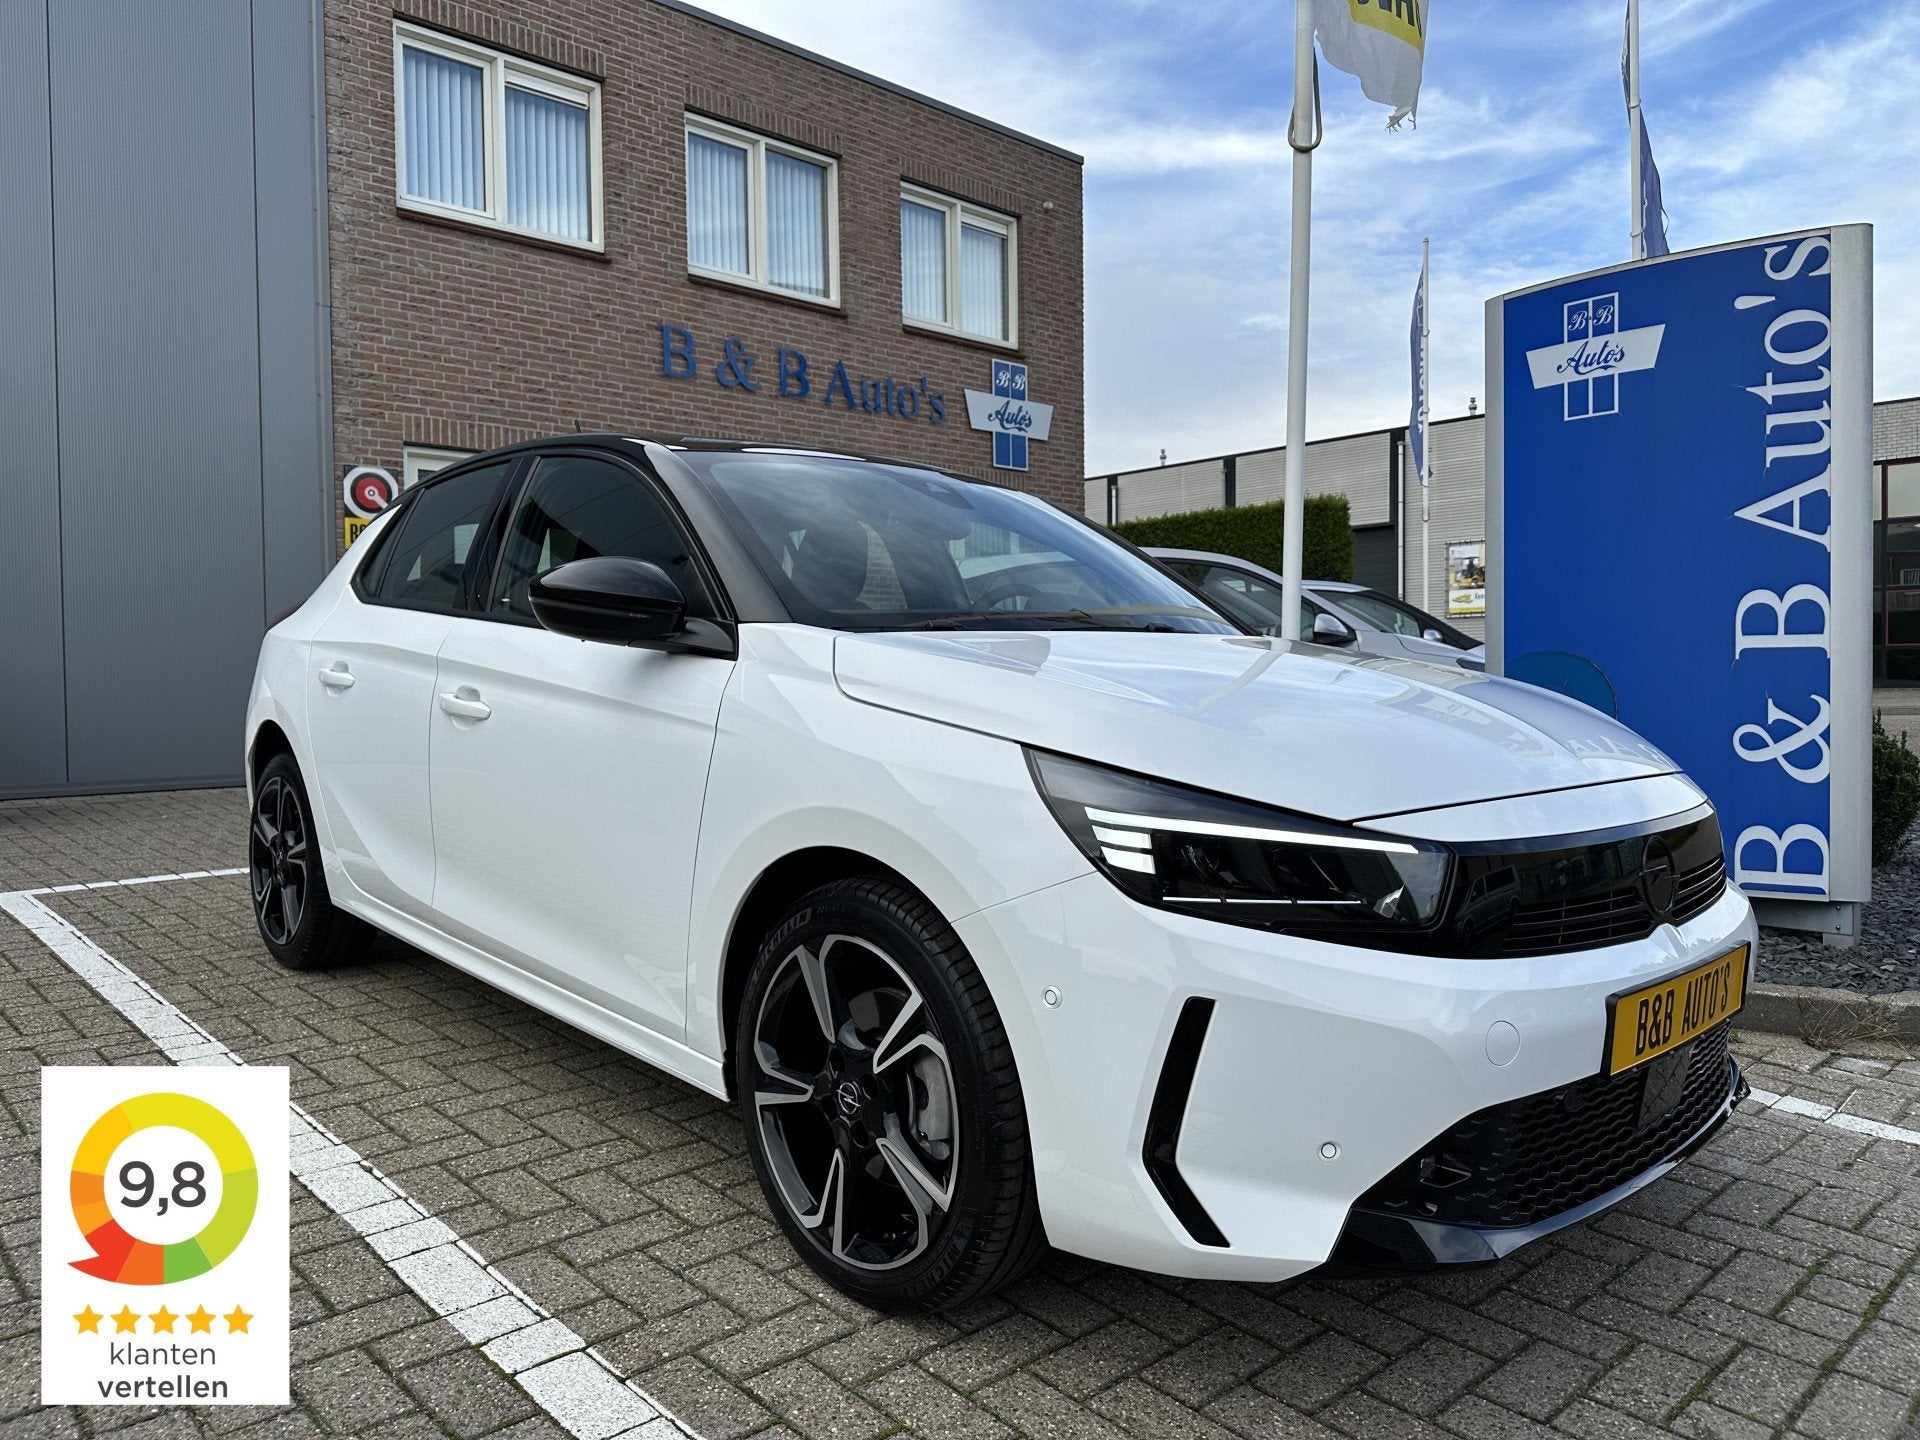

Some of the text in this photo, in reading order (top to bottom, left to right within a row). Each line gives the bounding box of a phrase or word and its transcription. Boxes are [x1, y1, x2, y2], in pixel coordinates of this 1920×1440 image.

[660, 324, 948, 425] B & B Auto's
[1557, 340, 1625, 375] Auto's
[988, 400, 1032, 433] Auto's
[1733, 236, 1831, 895] B & B Auto's
[1635, 961, 1731, 1056] B&B AUTO'S
